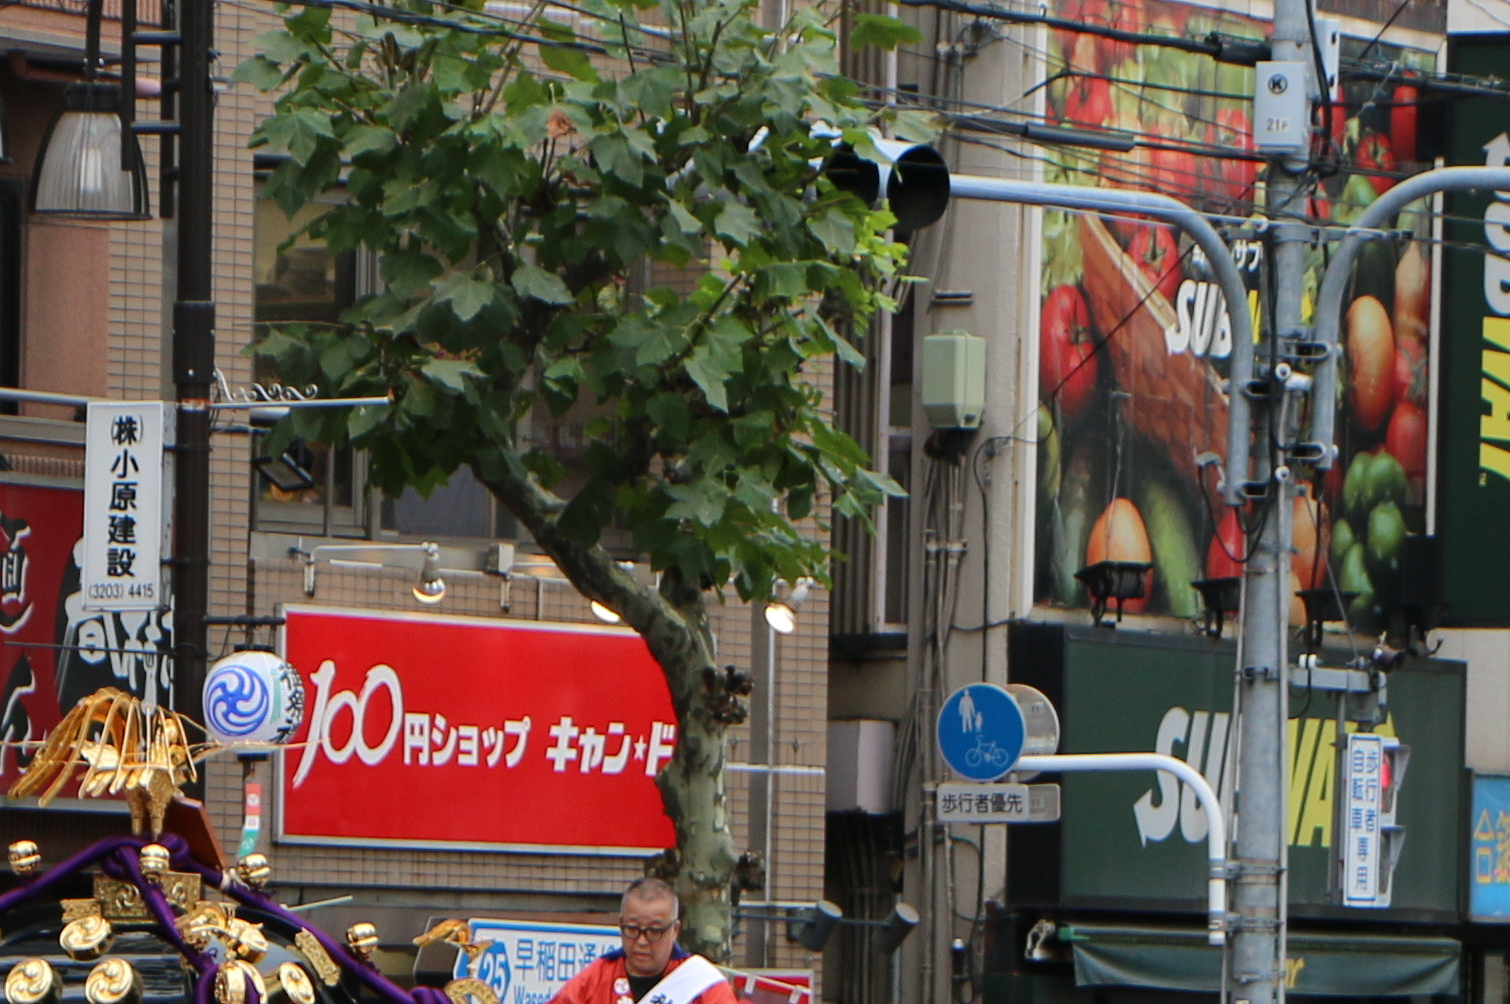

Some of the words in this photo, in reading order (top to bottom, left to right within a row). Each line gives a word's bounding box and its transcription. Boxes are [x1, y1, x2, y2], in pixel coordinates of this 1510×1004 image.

[89, 584, 123, 600] (3203)
[129, 583, 154, 599] 4415
[292, 660, 531, 789] 100円ショップ
[942, 792, 1024, 813] 歩行者優先
[483, 952, 506, 992] 25
